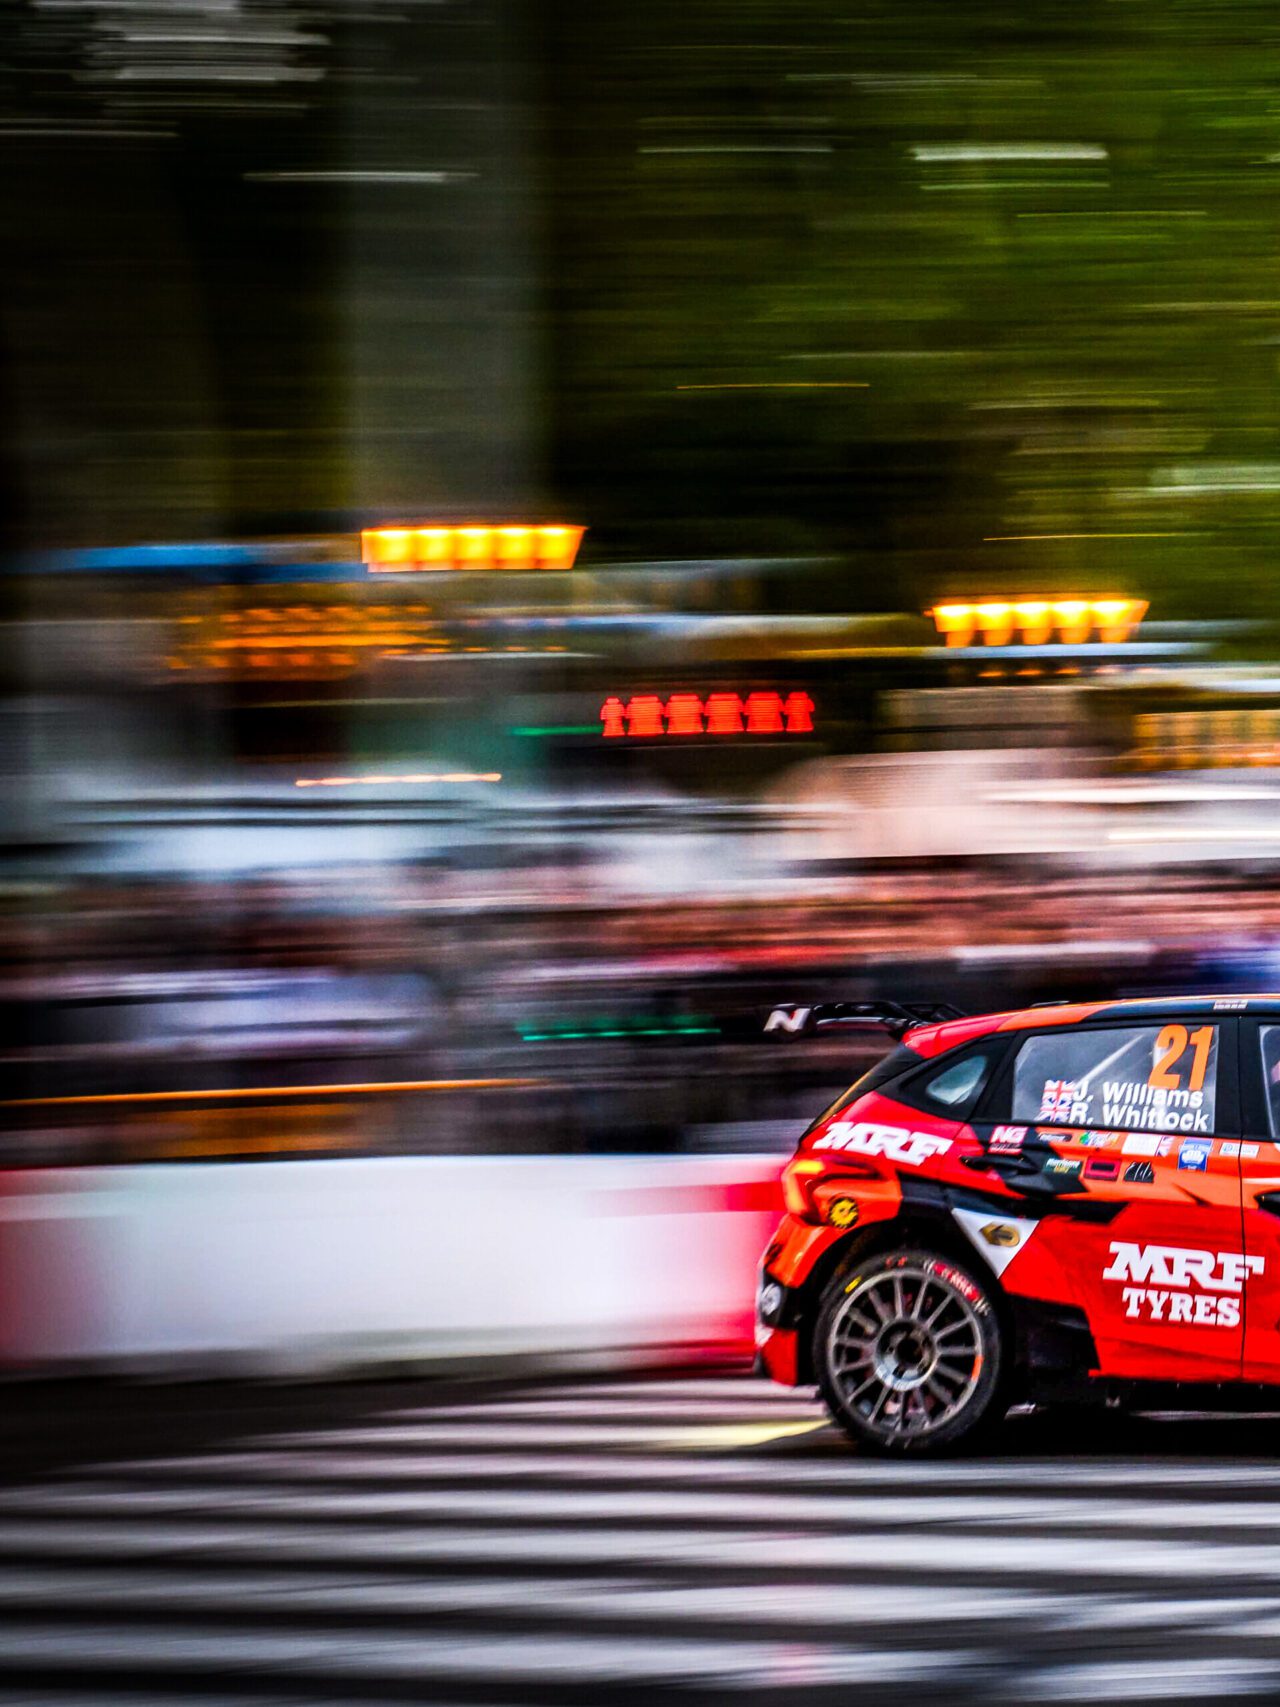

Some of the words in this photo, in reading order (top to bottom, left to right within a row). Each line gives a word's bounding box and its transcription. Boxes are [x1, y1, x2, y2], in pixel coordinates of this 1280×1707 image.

[1147, 1024, 1214, 1091] 21
[1072, 1080, 1094, 1102] J.
[1102, 1081, 1204, 1109] Williams
[1069, 1103, 1094, 1125] R.
[1102, 1104, 1210, 1132] Whittock
[811, 1121, 954, 1166] MRF
[1102, 1240, 1265, 1293] MRF
[1121, 1287, 1241, 1328] TYRES
